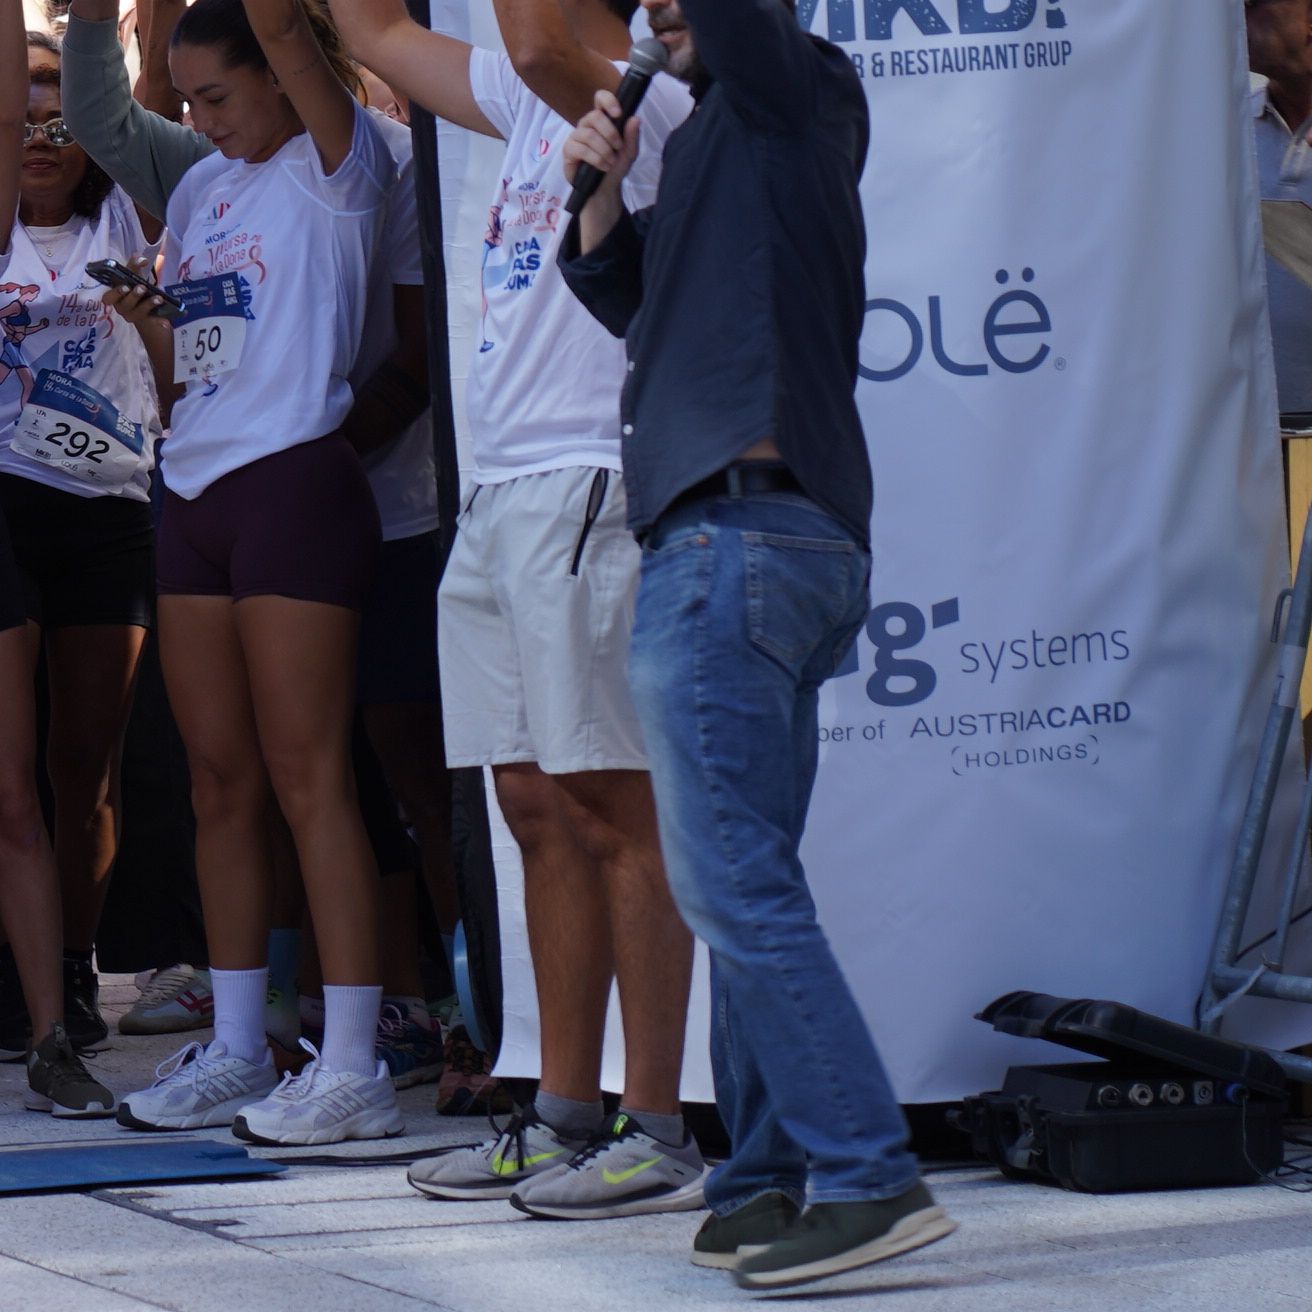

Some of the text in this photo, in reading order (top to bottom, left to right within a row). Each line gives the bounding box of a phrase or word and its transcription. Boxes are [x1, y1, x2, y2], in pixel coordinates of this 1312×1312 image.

[872, 52, 884, 78] &
[891, 43, 1021, 77] RESTAURANT
[1025, 40, 1073, 68] GRUP
[512, 253, 540, 272] AS
[194, 325, 221, 361] 50
[45, 422, 110, 464] 292
[960, 629, 1131, 684] systems
[862, 719, 887, 740] of
[909, 701, 1131, 738] AUSTRIACARD
